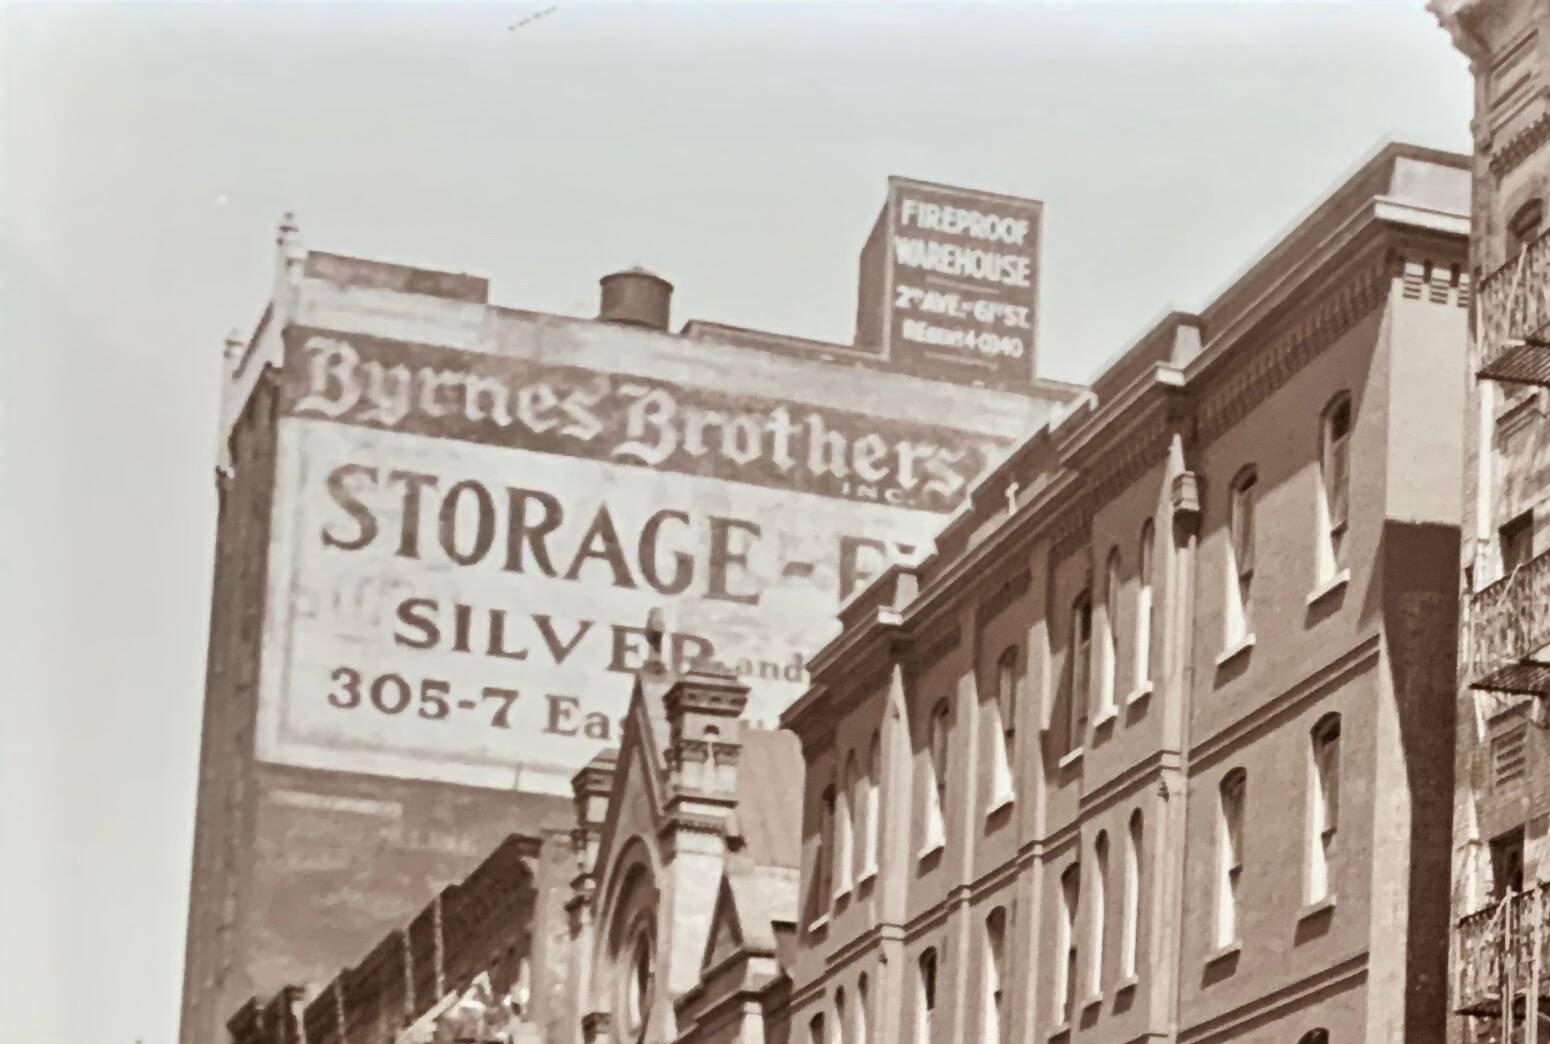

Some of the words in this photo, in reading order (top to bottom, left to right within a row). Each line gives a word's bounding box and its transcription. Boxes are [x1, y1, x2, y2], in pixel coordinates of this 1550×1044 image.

[901, 199, 1029, 246] FIREPROOF
[895, 235, 1031, 287] WAREHOUSE
[293, 335, 611, 441] Byrnes
[611, 383, 966, 496] Brothers
[321, 463, 761, 606] STORAGE
[327, 666, 519, 729] 305-7
